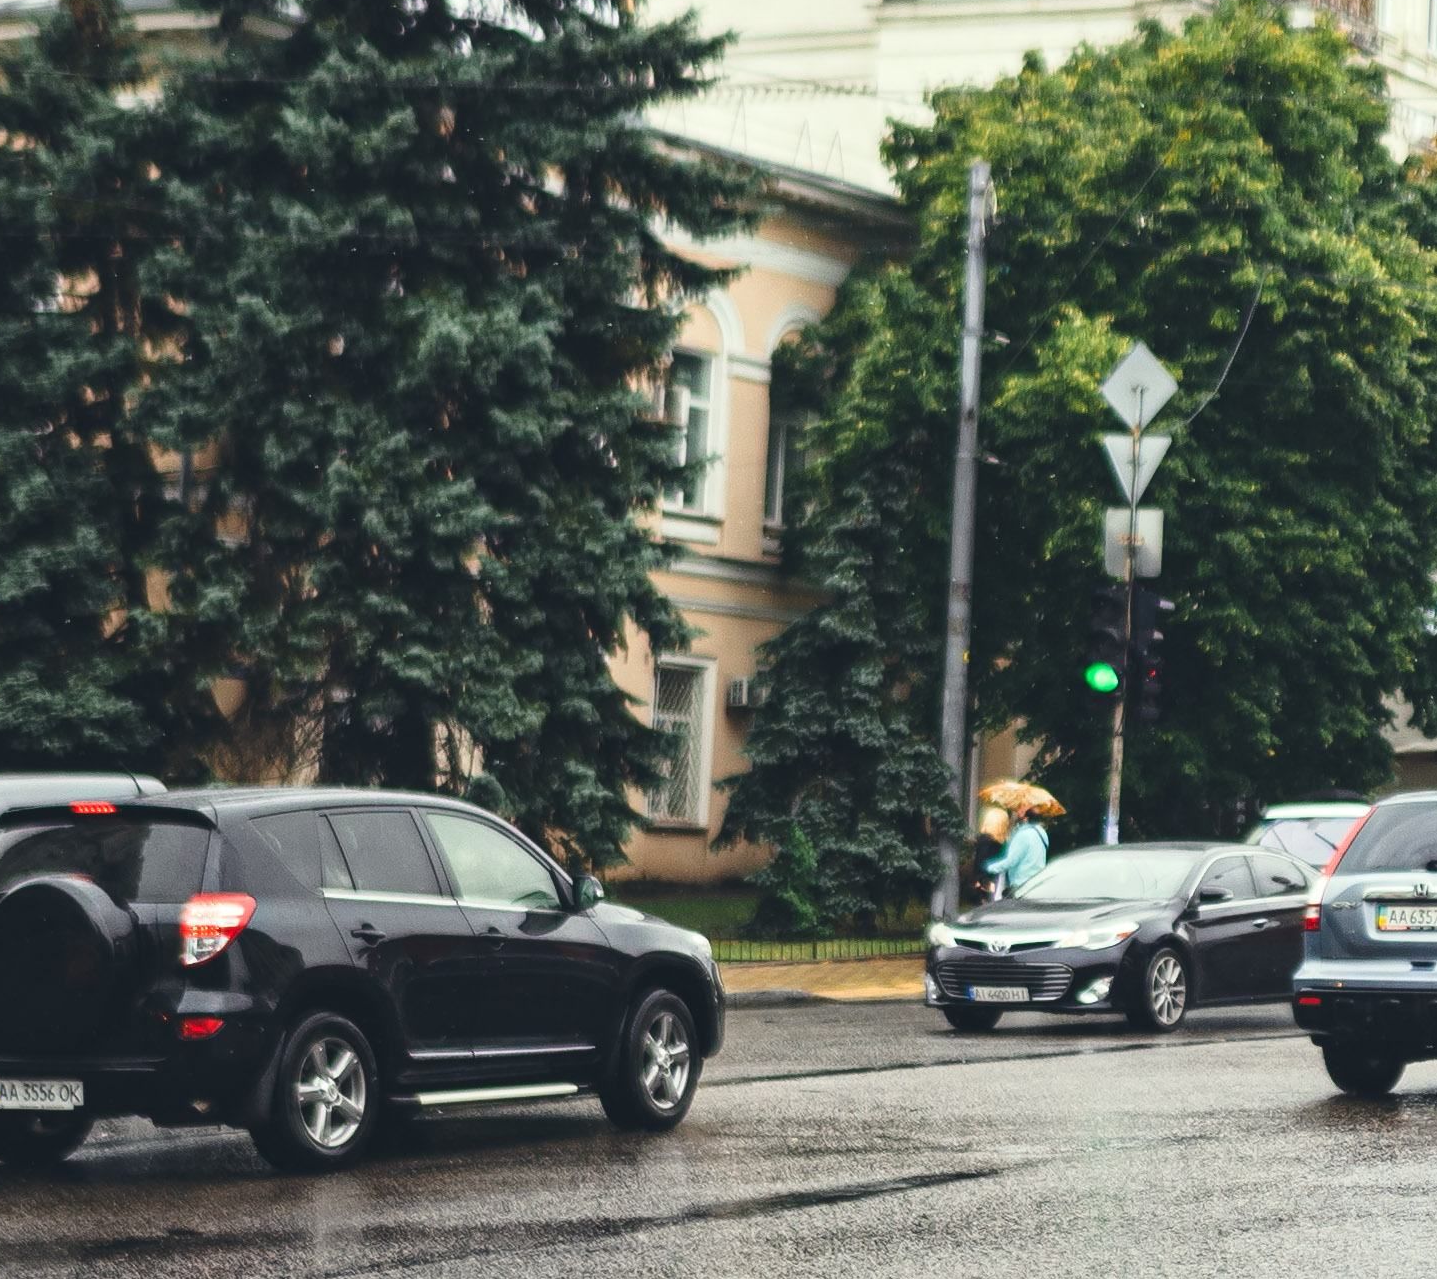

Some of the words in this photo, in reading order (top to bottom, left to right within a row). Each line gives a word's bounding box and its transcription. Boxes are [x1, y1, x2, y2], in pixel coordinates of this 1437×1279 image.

[1389, 909, 1407, 924] AA
[0, 1082, 20, 1101] AA
[22, 1082, 56, 1102] 3556
[58, 1083, 81, 1103] OK
